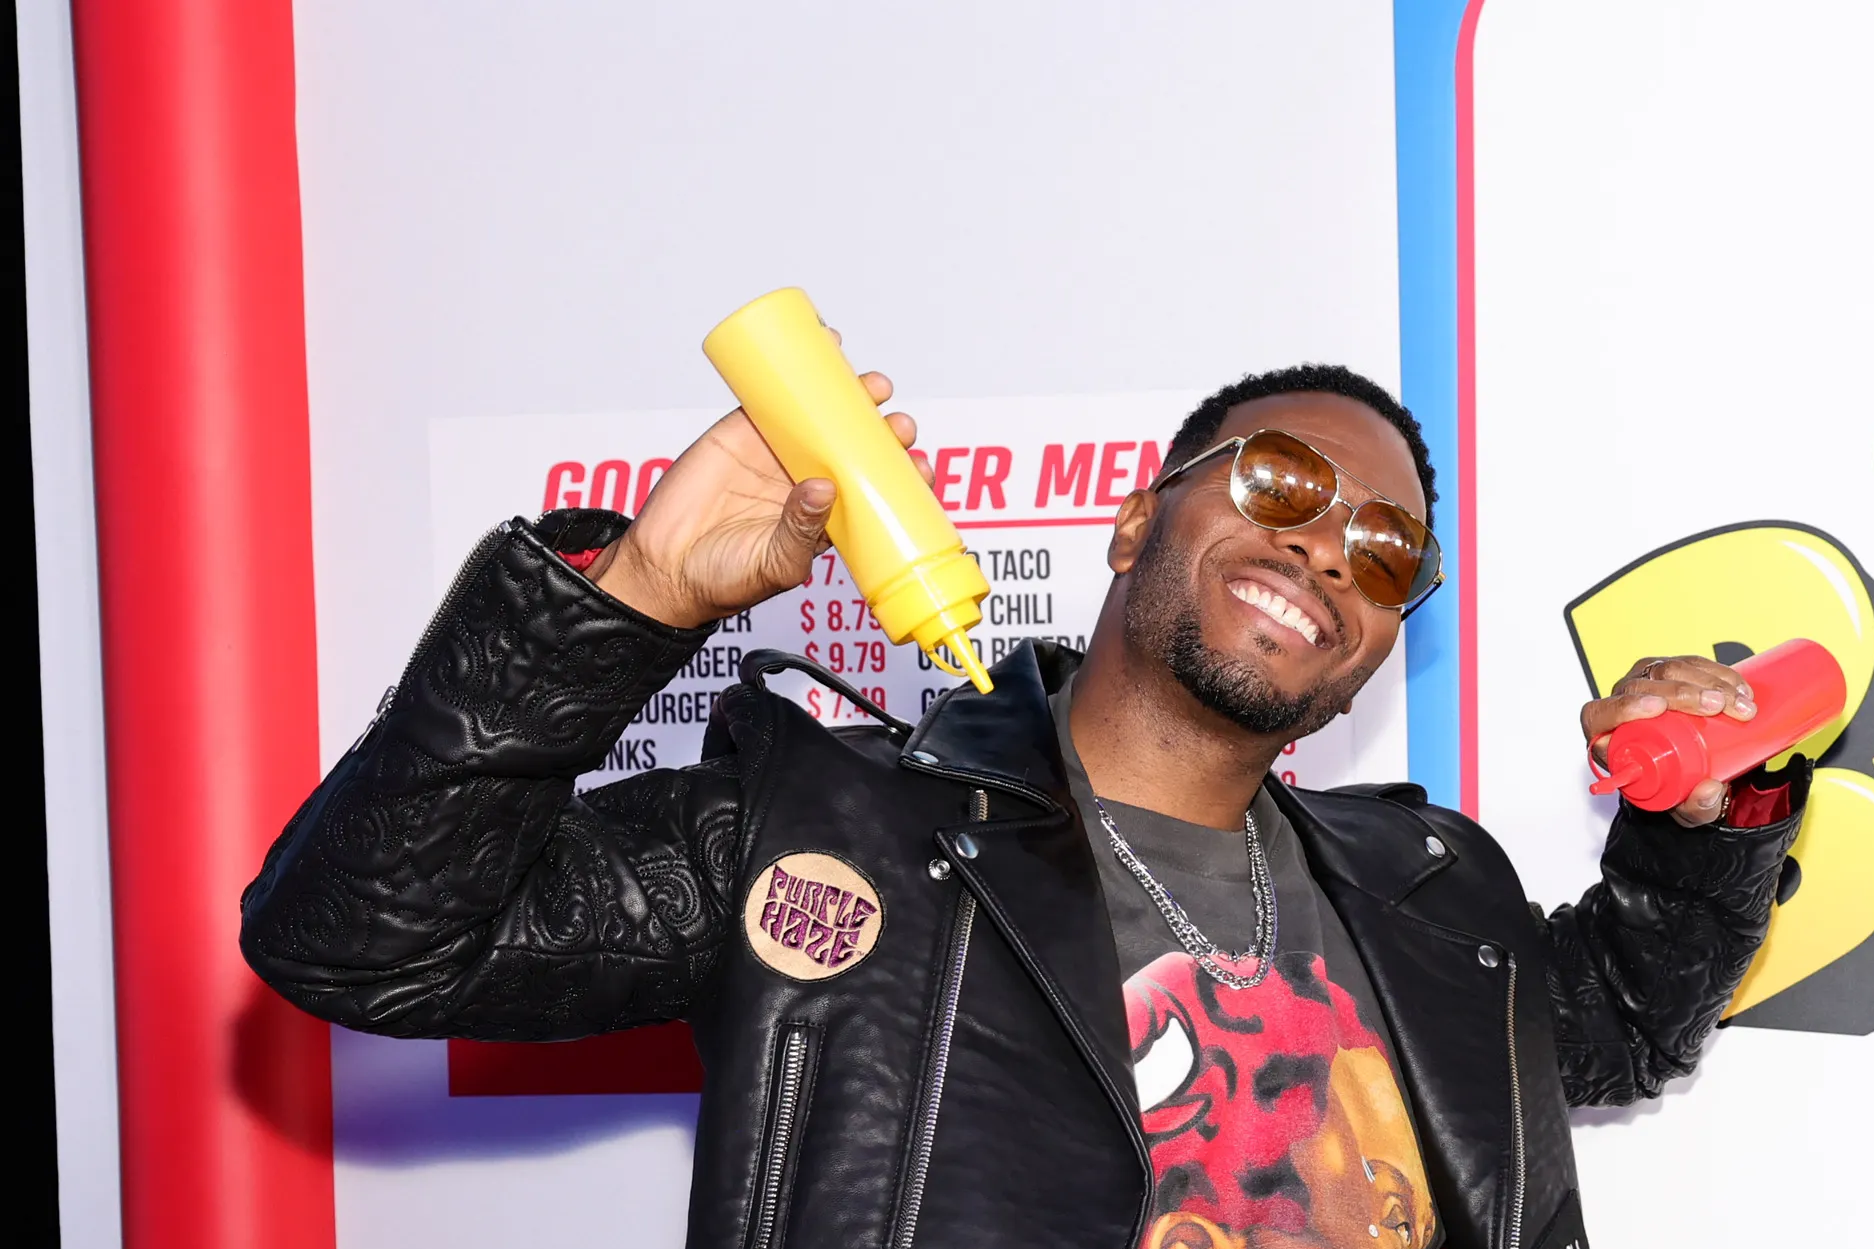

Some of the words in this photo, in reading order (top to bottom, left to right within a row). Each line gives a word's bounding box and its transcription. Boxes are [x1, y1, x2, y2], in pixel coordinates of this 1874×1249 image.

[543, 458, 676, 520] GOO
[1035, 441, 1174, 507] MEN
[988, 549, 1052, 581] TACO
[990, 593, 1053, 625] CHILI
[829, 641, 886, 674] 9.79
[766, 864, 877, 929] PURPLE
